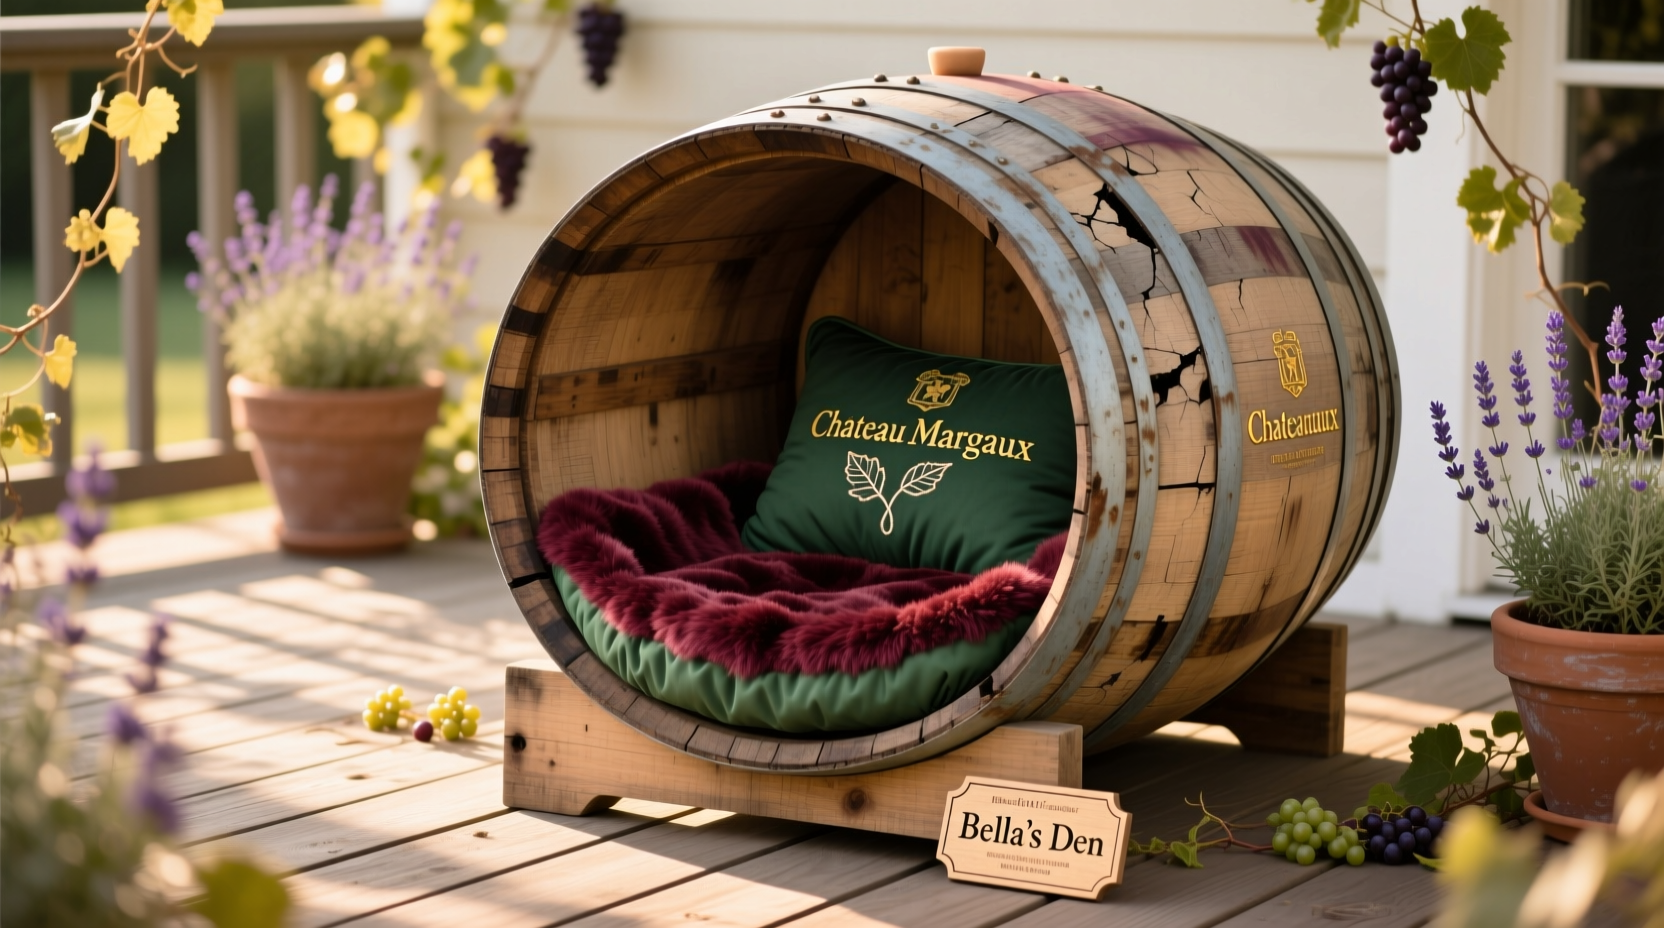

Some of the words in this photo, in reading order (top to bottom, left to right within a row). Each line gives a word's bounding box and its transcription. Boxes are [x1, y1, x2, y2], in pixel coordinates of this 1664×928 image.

[811, 410, 907, 443] Chateau
[908, 418, 1035, 461] Margaux
[957, 811, 1042, 849] Bella's
[1048, 822, 1104, 857] Den
